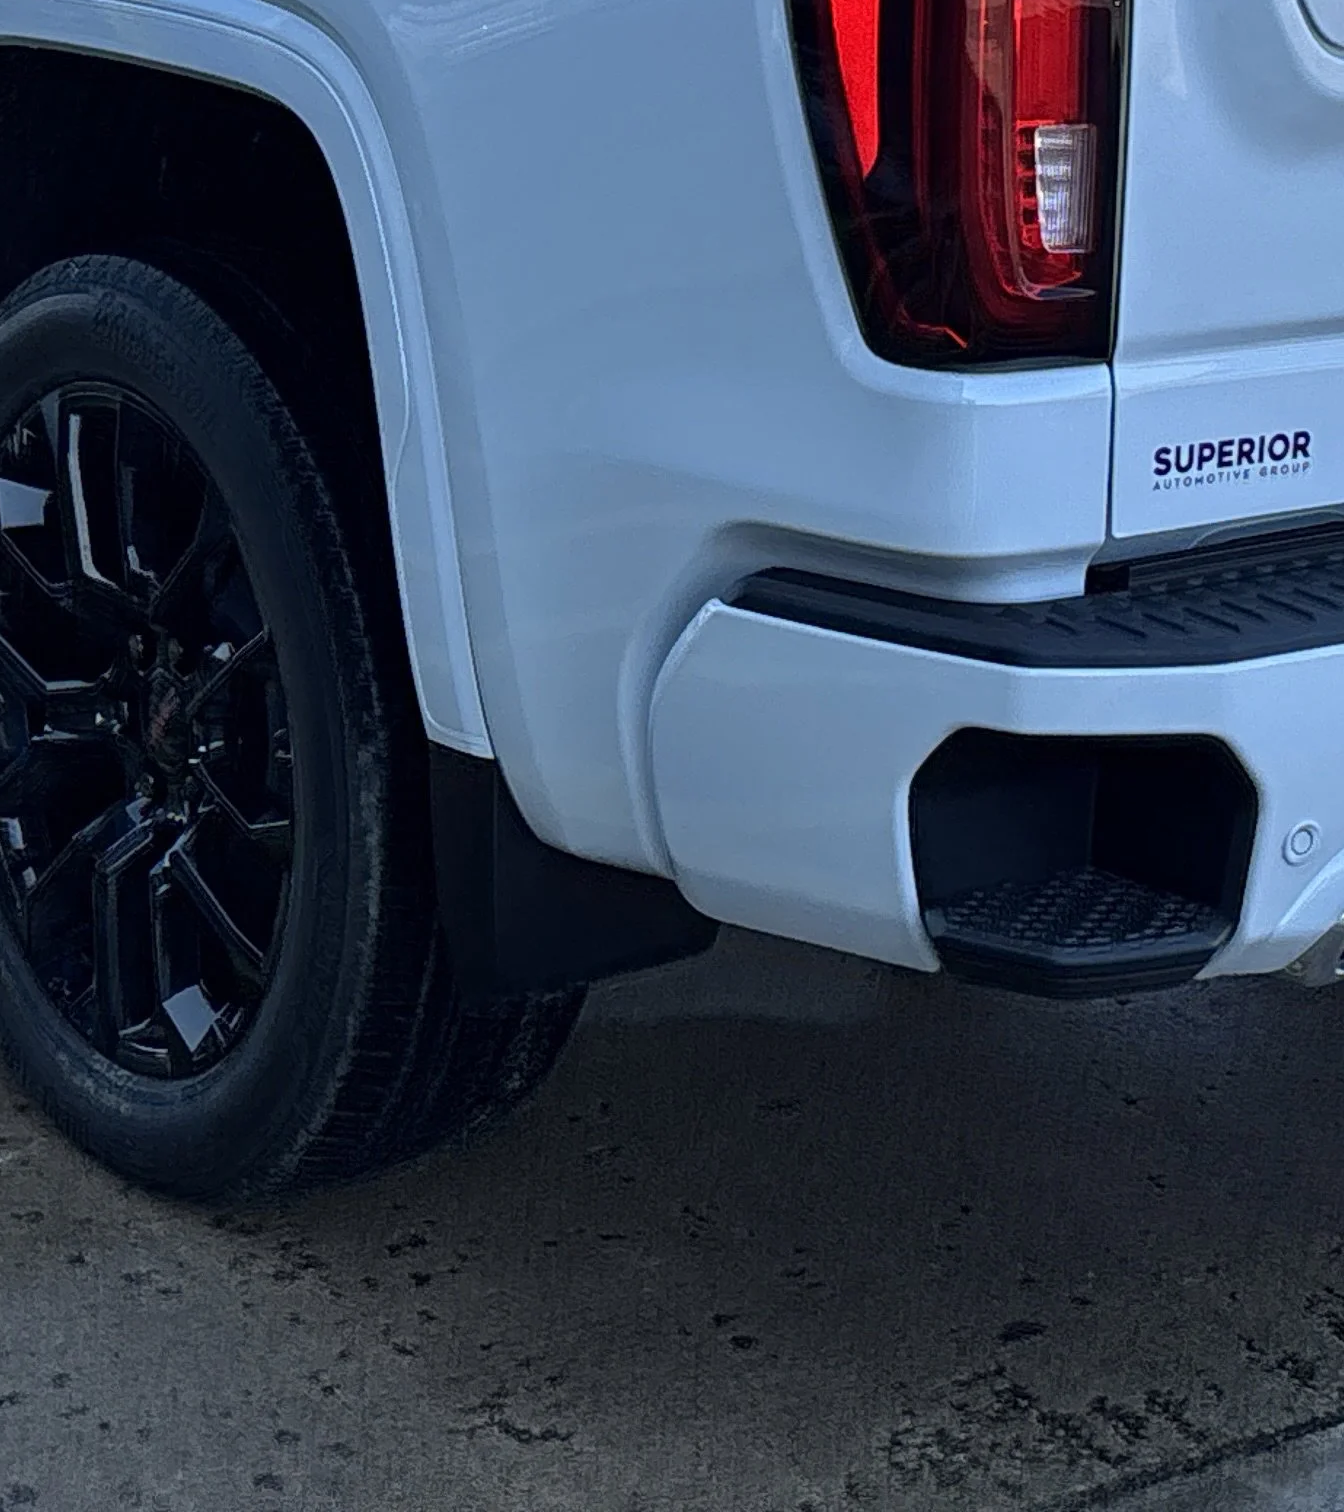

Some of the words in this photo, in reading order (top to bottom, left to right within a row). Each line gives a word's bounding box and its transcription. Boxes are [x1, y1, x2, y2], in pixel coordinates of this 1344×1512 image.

[1153, 430, 1311, 476] SUPERIOR
[1152, 468, 1250, 491] AUTOMOTIVE
[1258, 461, 1310, 478] GROUP
